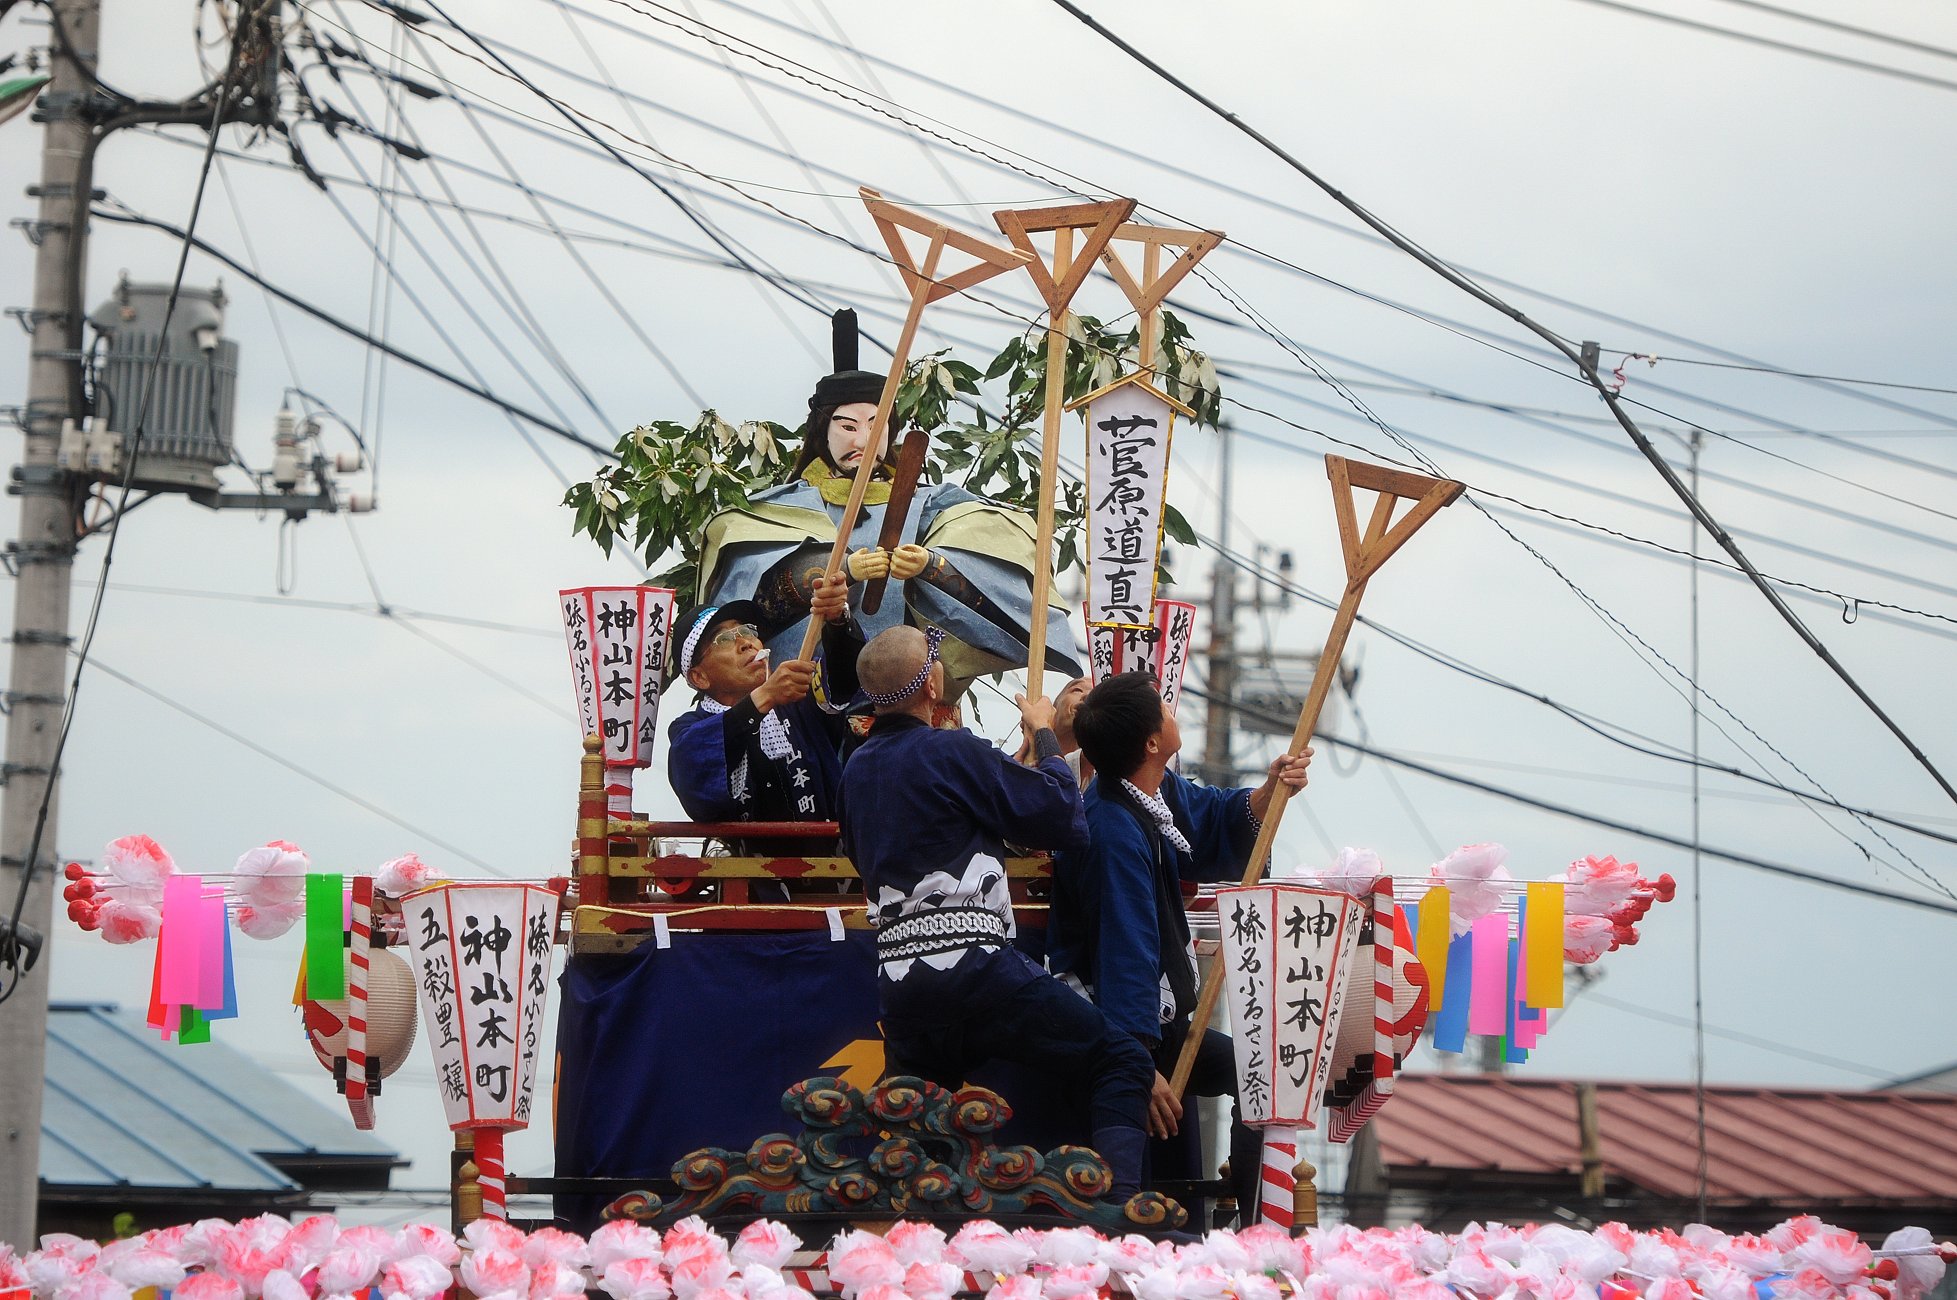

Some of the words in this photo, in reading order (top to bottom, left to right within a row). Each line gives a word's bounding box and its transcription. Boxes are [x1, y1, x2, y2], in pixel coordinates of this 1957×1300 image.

[1096, 415, 1158, 623] 菅原道真
[565, 597, 594, 735] 榛名ふるさと
[597, 601, 637, 752] 神山本町
[639, 603, 665, 744] 交通安全
[460, 915, 514, 1103] 神山本町
[1279, 900, 1337, 1088] 神山本町
